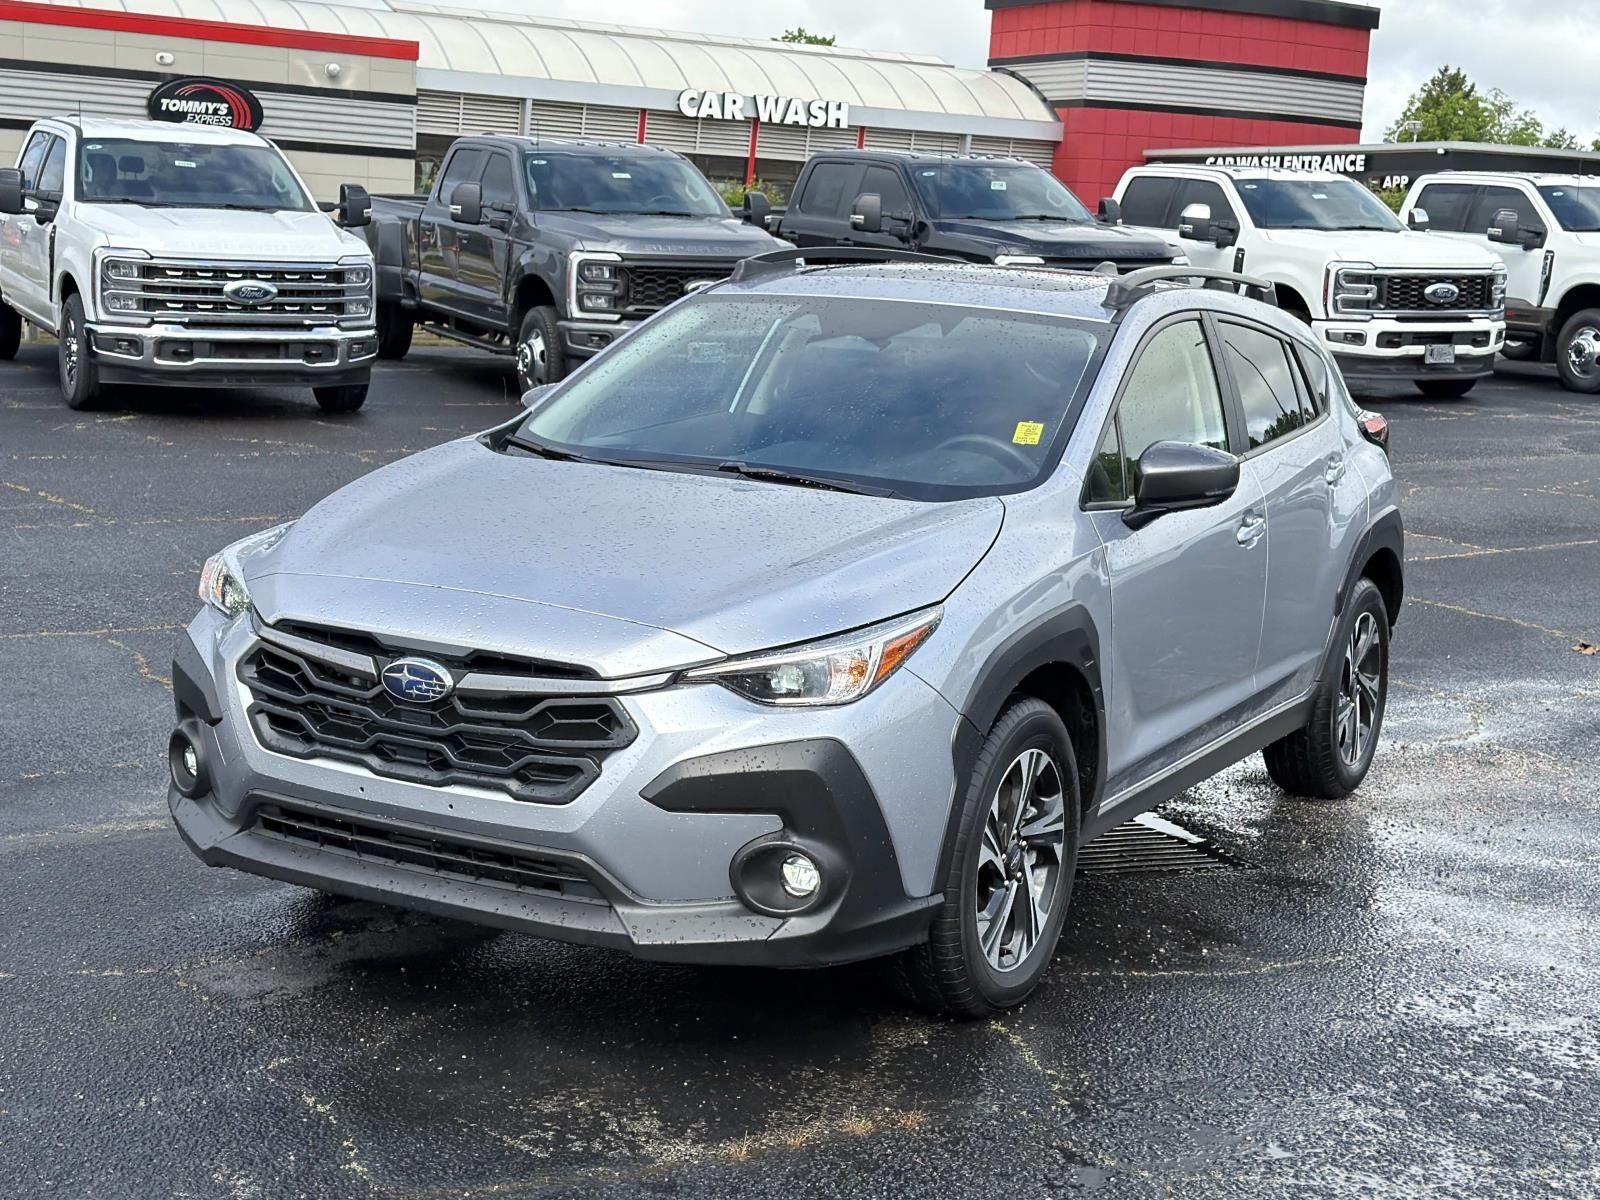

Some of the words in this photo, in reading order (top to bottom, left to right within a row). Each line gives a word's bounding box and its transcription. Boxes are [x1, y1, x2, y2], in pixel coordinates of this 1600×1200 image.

[160, 98, 229, 115] TOMMY'S
[679, 89, 745, 120] CAR
[755, 95, 849, 128] WASH
[186, 113, 232, 126] EXPRESS
[1236, 156, 1280, 168] WASH
[1283, 155, 1366, 172] ENTRANCE
[1382, 175, 1409, 189] APP
[240, 286, 264, 297] Ford
